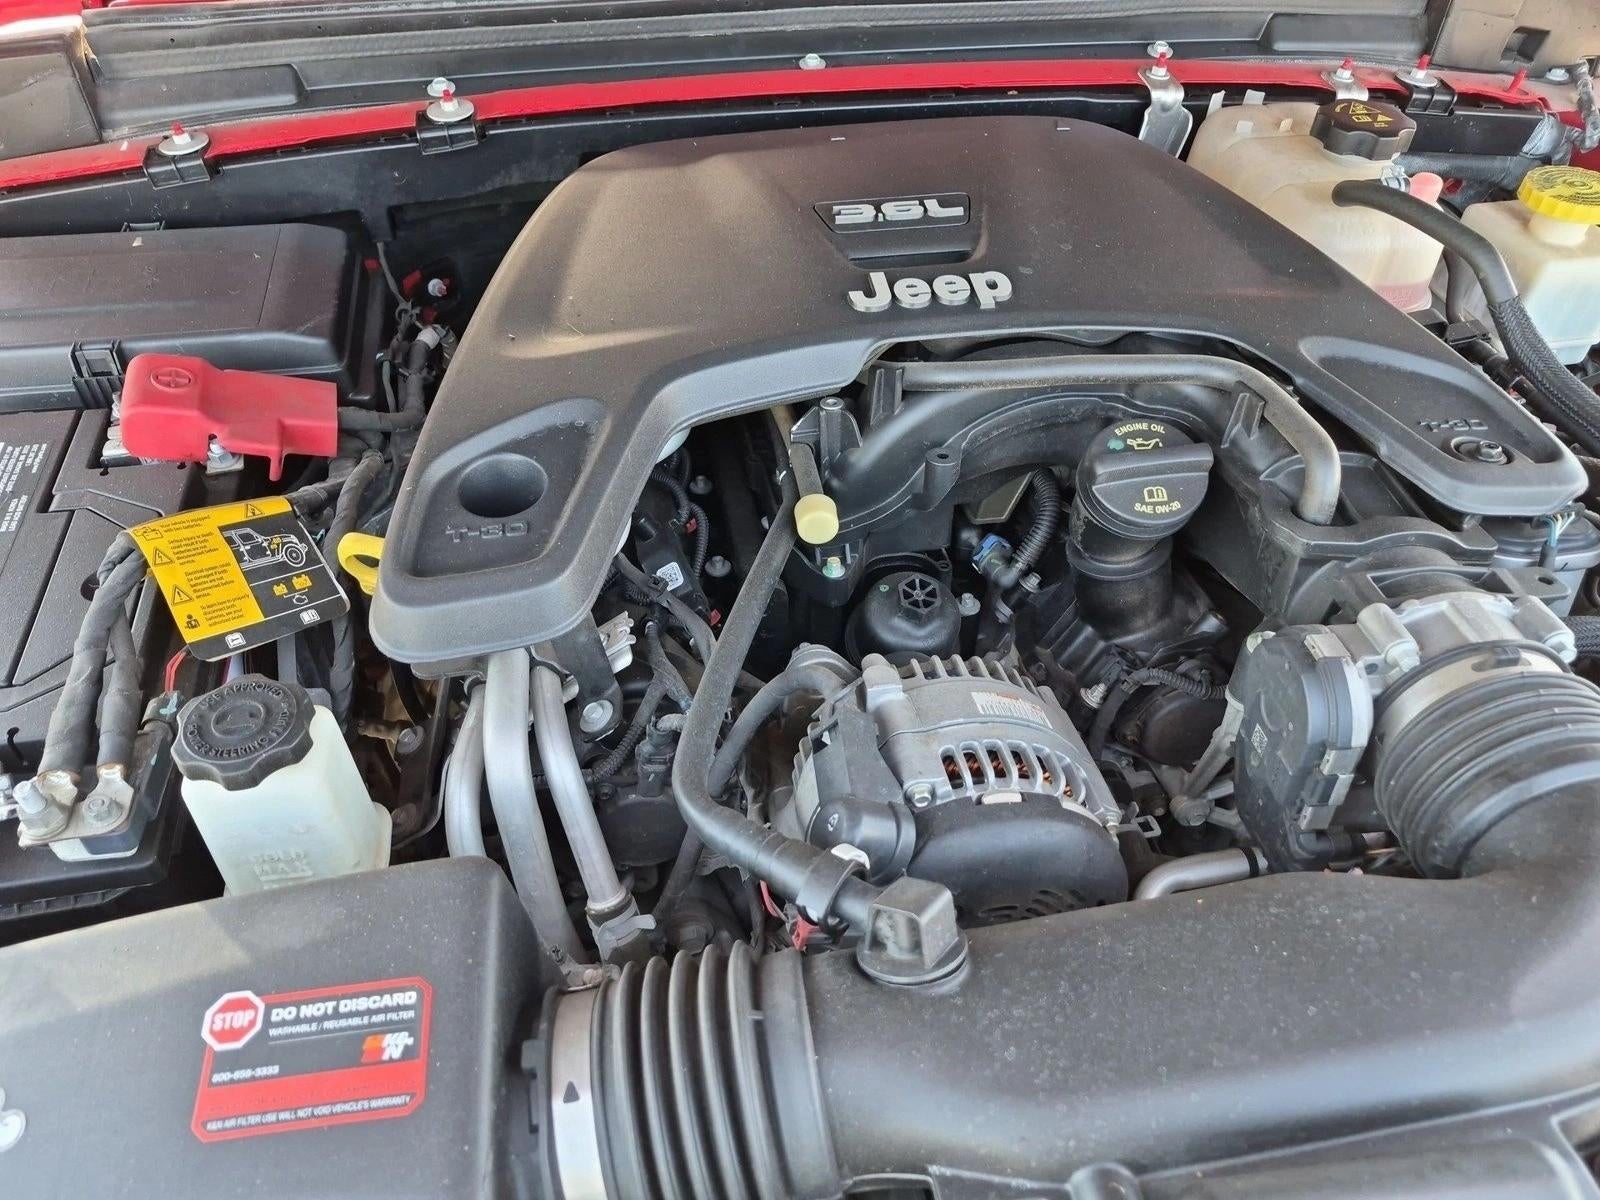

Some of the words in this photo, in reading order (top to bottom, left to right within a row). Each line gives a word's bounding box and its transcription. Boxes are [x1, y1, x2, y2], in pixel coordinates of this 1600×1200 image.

[832, 199, 965, 225] 3.6L
[848, 271, 1013, 312] Jeep
[1114, 422, 1148, 436] ENGINE
[1150, 423, 1166, 434] OIL
[1134, 502, 1154, 513] SAE
[1155, 500, 1182, 514] 0W-20
[200, 691, 222, 709] USE
[224, 682, 284, 699] APPROVED
[187, 722, 210, 755] POWER
[209, 736, 270, 758] STEERING
[270, 1006, 297, 1022] DO
[299, 1001, 337, 1019] NOT
[338, 991, 417, 1013] DISCARD
[212, 1009, 256, 1032] STOP
[268, 1022, 318, 1037] WASHABLE
[323, 1015, 369, 1031] REUSABLE
[370, 1013, 386, 1023] AIR
[386, 1009, 415, 1021] FILTER
